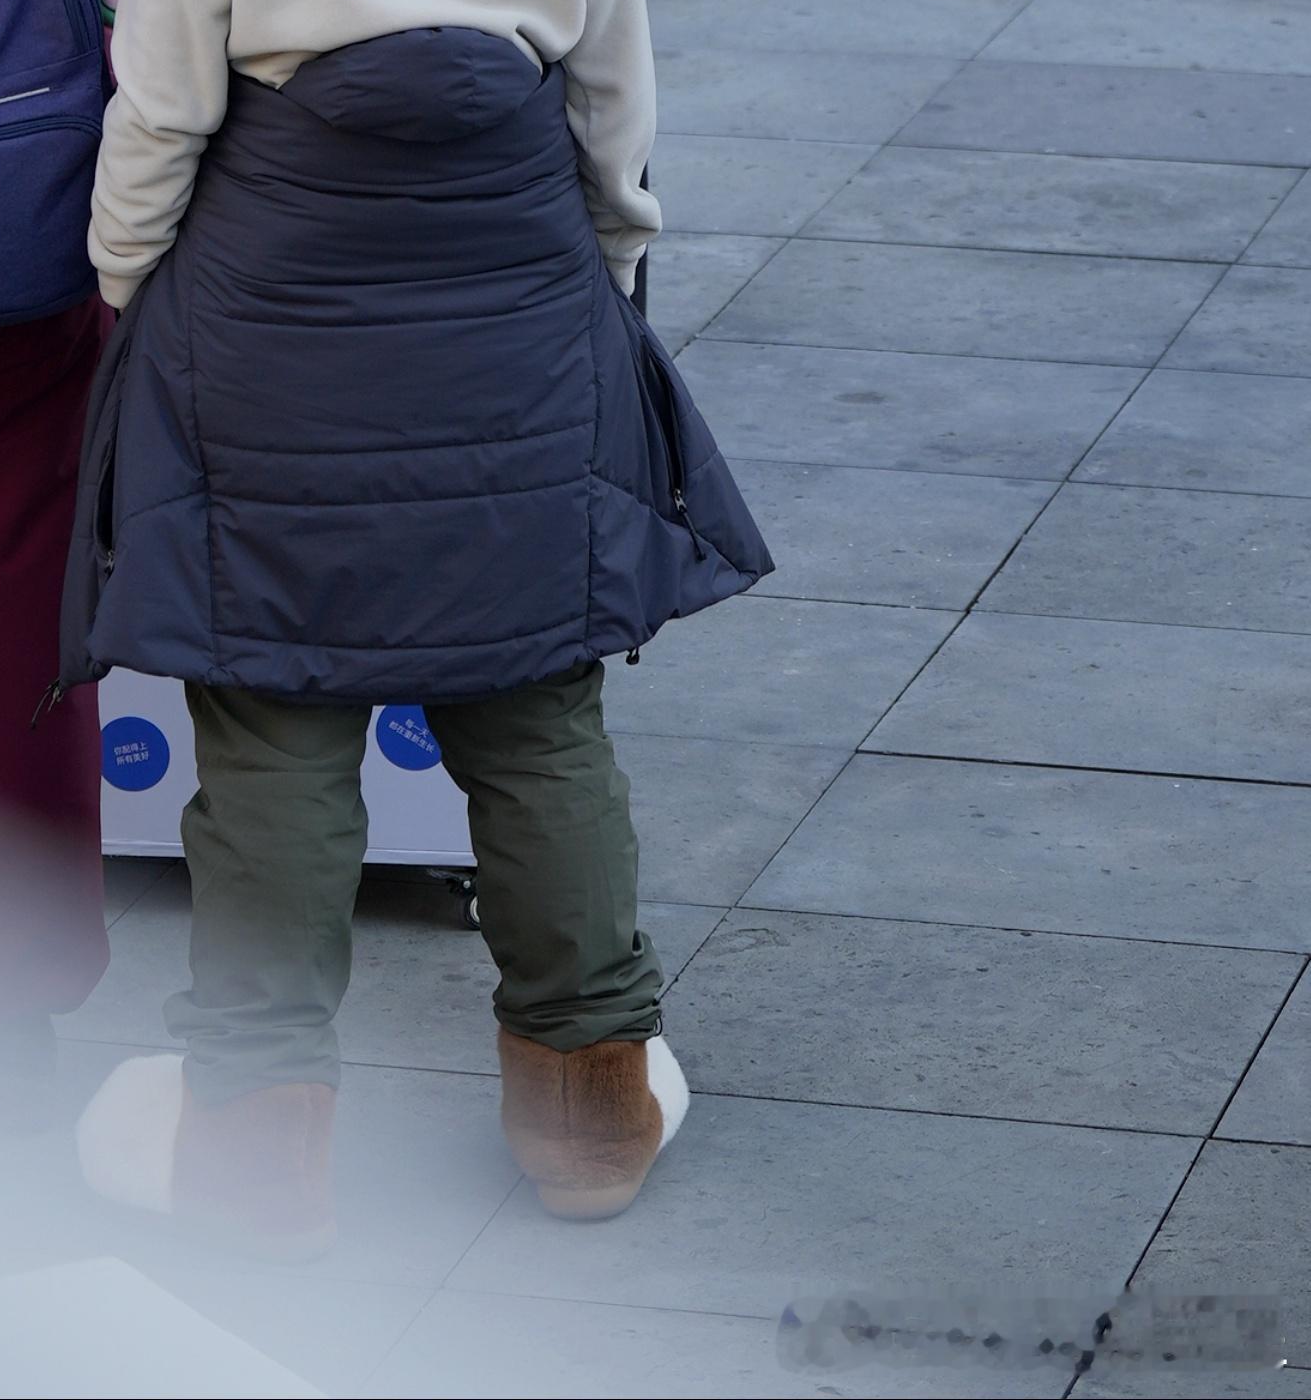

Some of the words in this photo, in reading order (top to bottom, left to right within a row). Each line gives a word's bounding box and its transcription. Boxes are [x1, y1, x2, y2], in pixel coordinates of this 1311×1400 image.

[388, 720, 436, 754] 都在重新生长
[406, 718, 430, 739] 每一天
[114, 741, 148, 756] 你配得上
[116, 752, 150, 766] 所有美好
